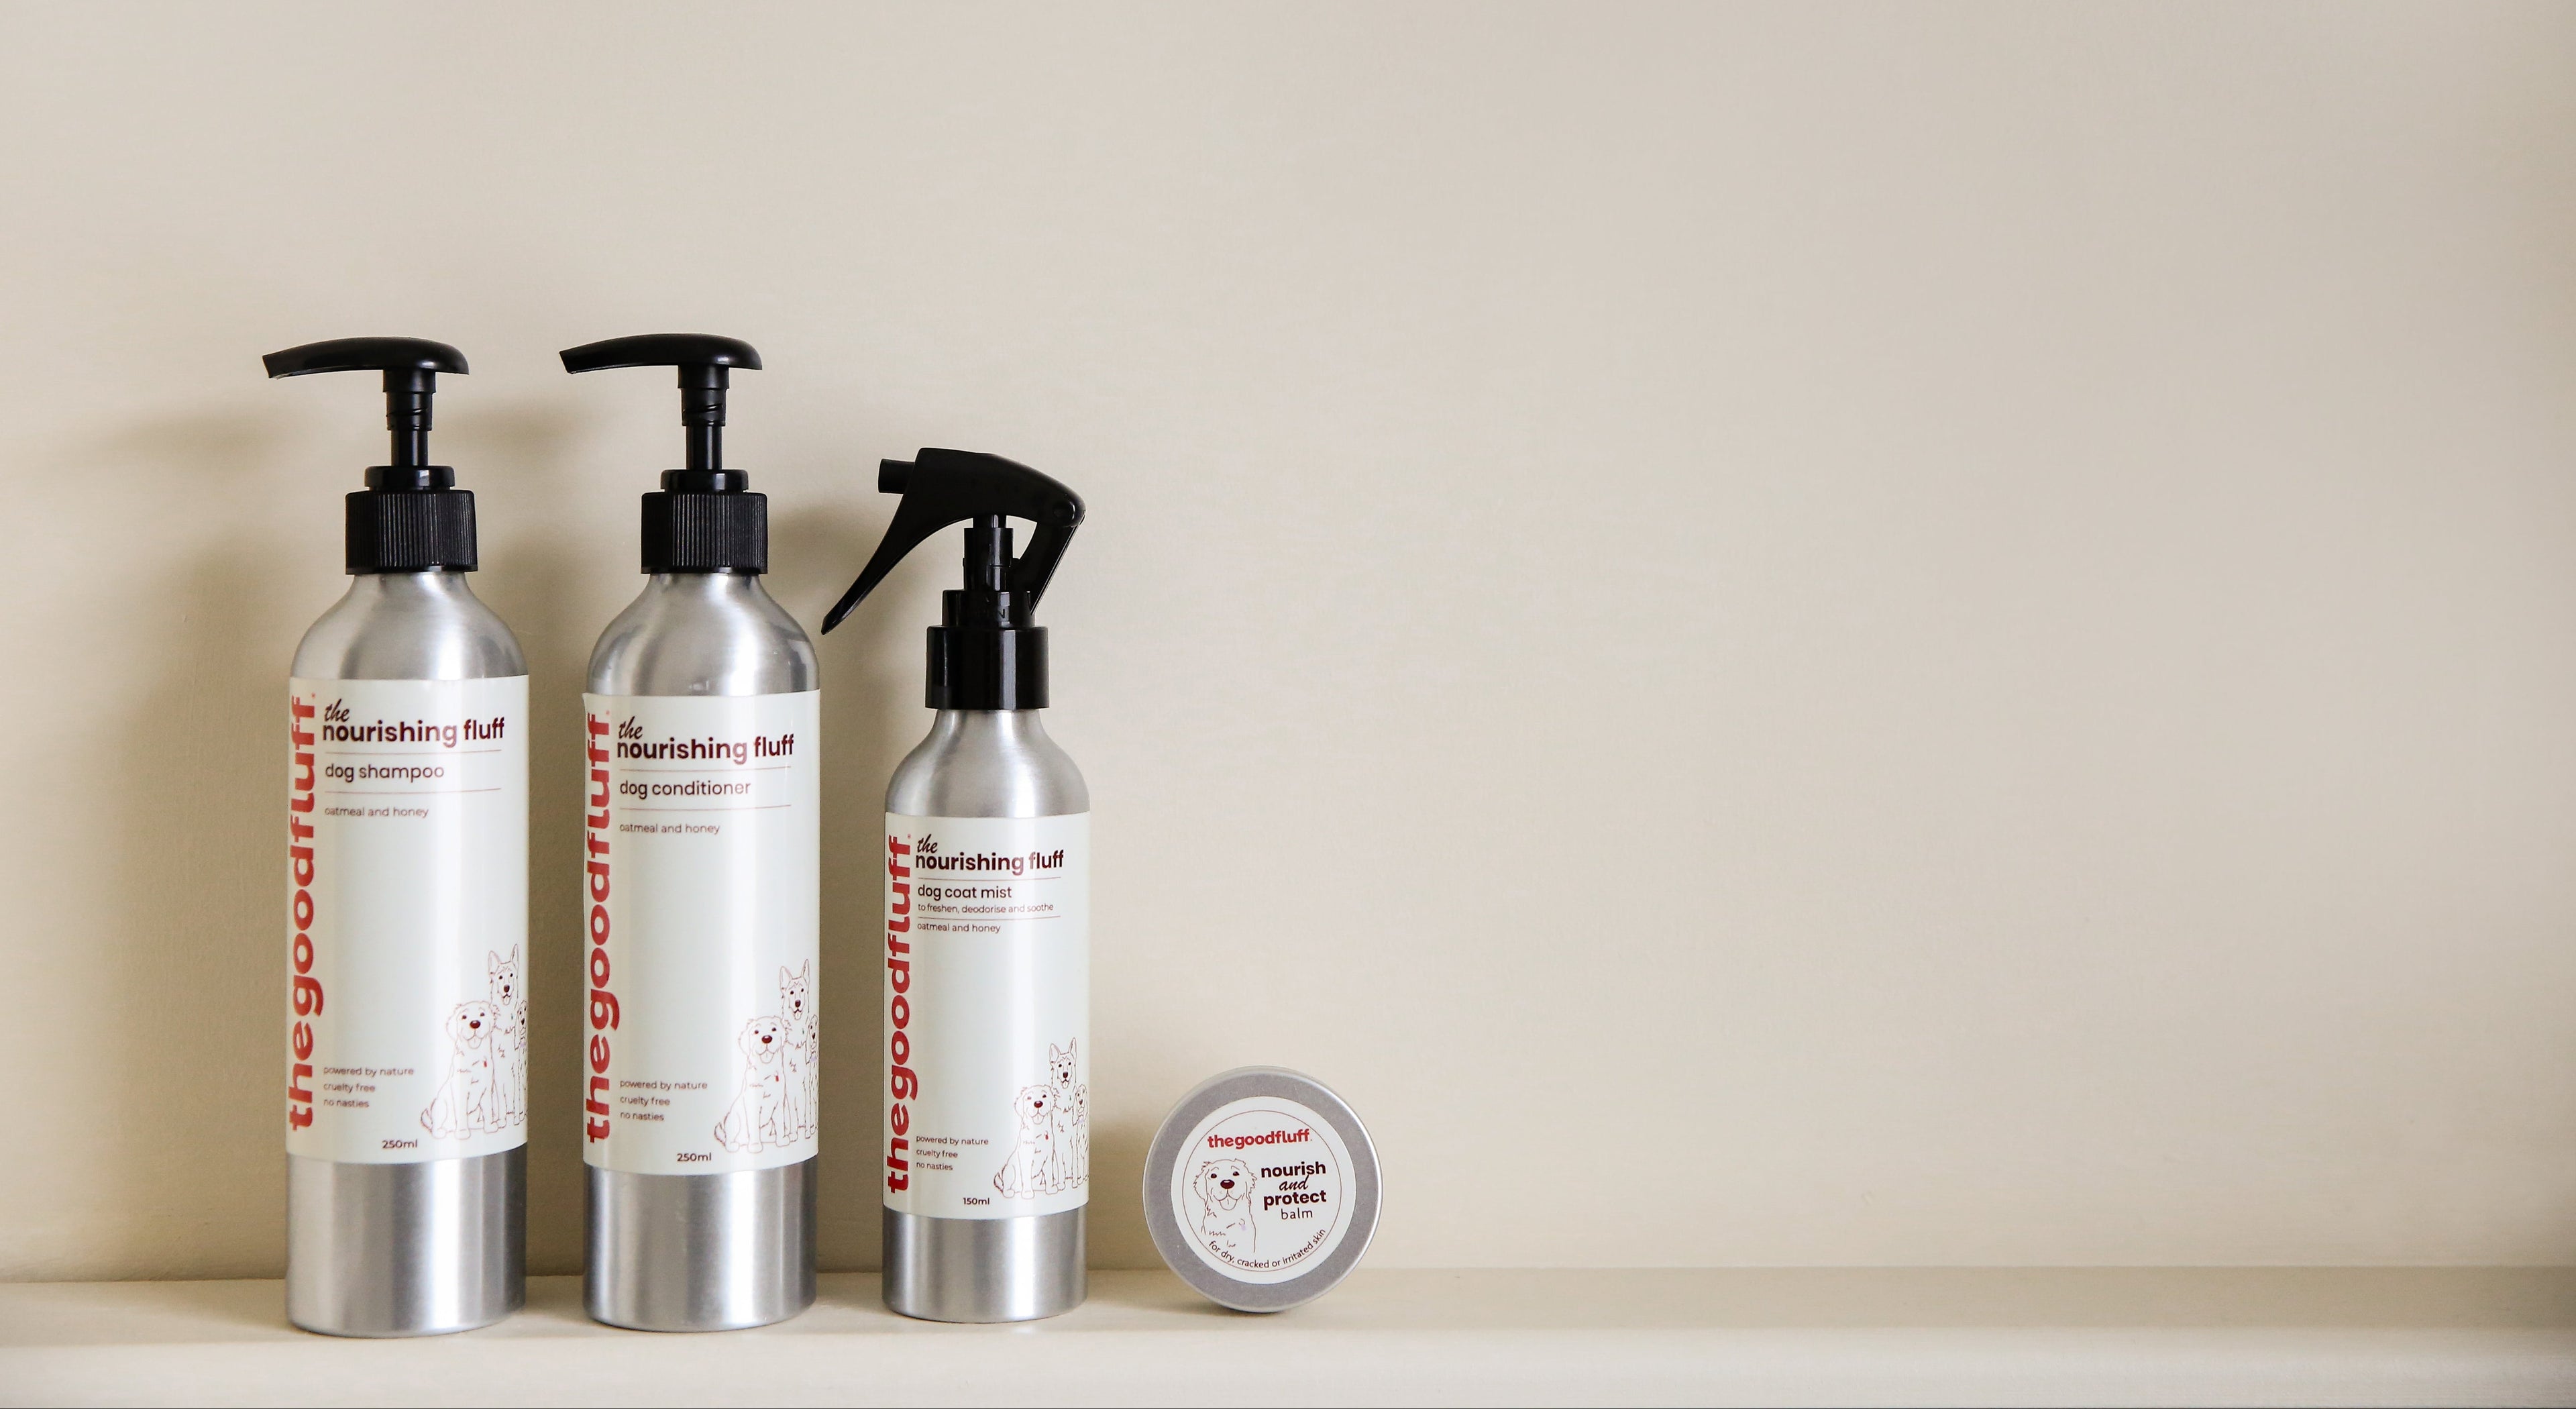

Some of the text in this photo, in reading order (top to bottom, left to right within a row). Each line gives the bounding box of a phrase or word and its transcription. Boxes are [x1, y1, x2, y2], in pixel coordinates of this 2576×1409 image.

[324, 698, 350, 722] the
[323, 717, 504, 748] nourishing fluff
[619, 716, 643, 739] the
[617, 734, 794, 765] nourishing fluff
[325, 764, 445, 783] dog shampoo
[620, 780, 751, 799] dog conditioner
[325, 806, 429, 819] oatmeal and honey
[620, 823, 720, 835] oatmeal and honey
[917, 834, 938, 853] the
[916, 849, 1064, 876] nourishing fluff
[918, 885, 1012, 901] dog coat mist
[927, 904, 960, 913] freshen,
[961, 905, 1006, 913] deodorise
[1008, 904, 1025, 912] and
[1027, 903, 1053, 912] soothe
[917, 923, 1001, 933] oatmeal and honey
[323, 1066, 414, 1077] powered by nature
[323, 1083, 376, 1093] cruelty free
[620, 1080, 708, 1091] powered by nature
[336, 1100, 370, 1108] nasties
[620, 1096, 670, 1106] cruelty free
[632, 1113, 664, 1121] nasties
[382, 1139, 418, 1149] 250ml
[916, 1135, 947, 1144] powered
[949, 1137, 959, 1145] by
[677, 1152, 712, 1162] 250ml
[916, 1149, 940, 1158] cruelty
[1261, 1161, 1326, 1178] nourish
[1279, 1175, 1309, 1191] and
[1263, 1190, 1327, 1210] protect
[1281, 1208, 1313, 1220] balm
[1209, 1241, 1221, 1253] for
[1221, 1250, 1235, 1263] dry,
[1237, 1258, 1269, 1268] cracked
[1283, 1241, 1313, 1265] irritated
[1312, 1229, 1326, 1246] skin
